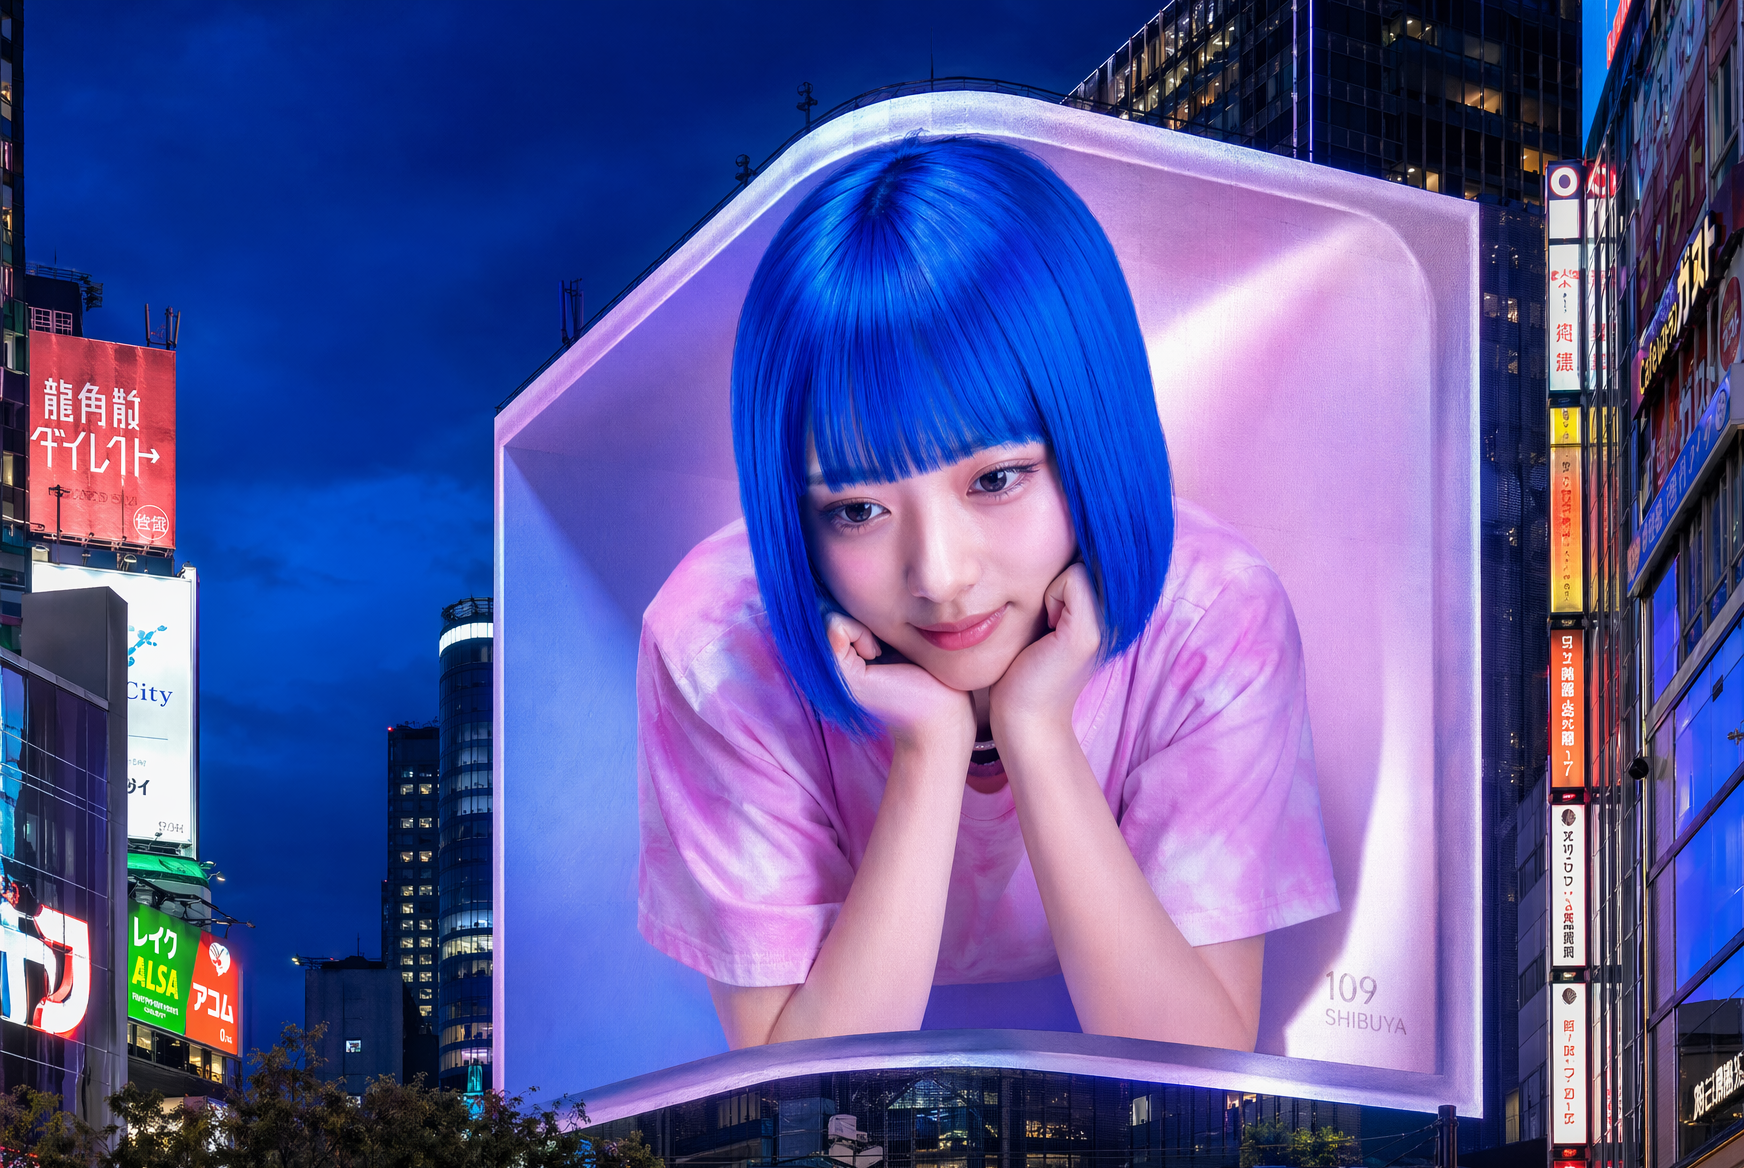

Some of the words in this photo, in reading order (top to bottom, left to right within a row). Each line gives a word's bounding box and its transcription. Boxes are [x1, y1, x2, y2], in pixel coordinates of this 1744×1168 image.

[1676, 214, 1716, 338] ガスト
[44, 378, 141, 430] 龍角散
[127, 681, 173, 707] City
[133, 916, 178, 960] レイク
[132, 956, 179, 1000] ALSA
[1325, 970, 1377, 1005] 109
[192, 982, 234, 1024] アコム
[1325, 1008, 1407, 1035] SHIBUYA
